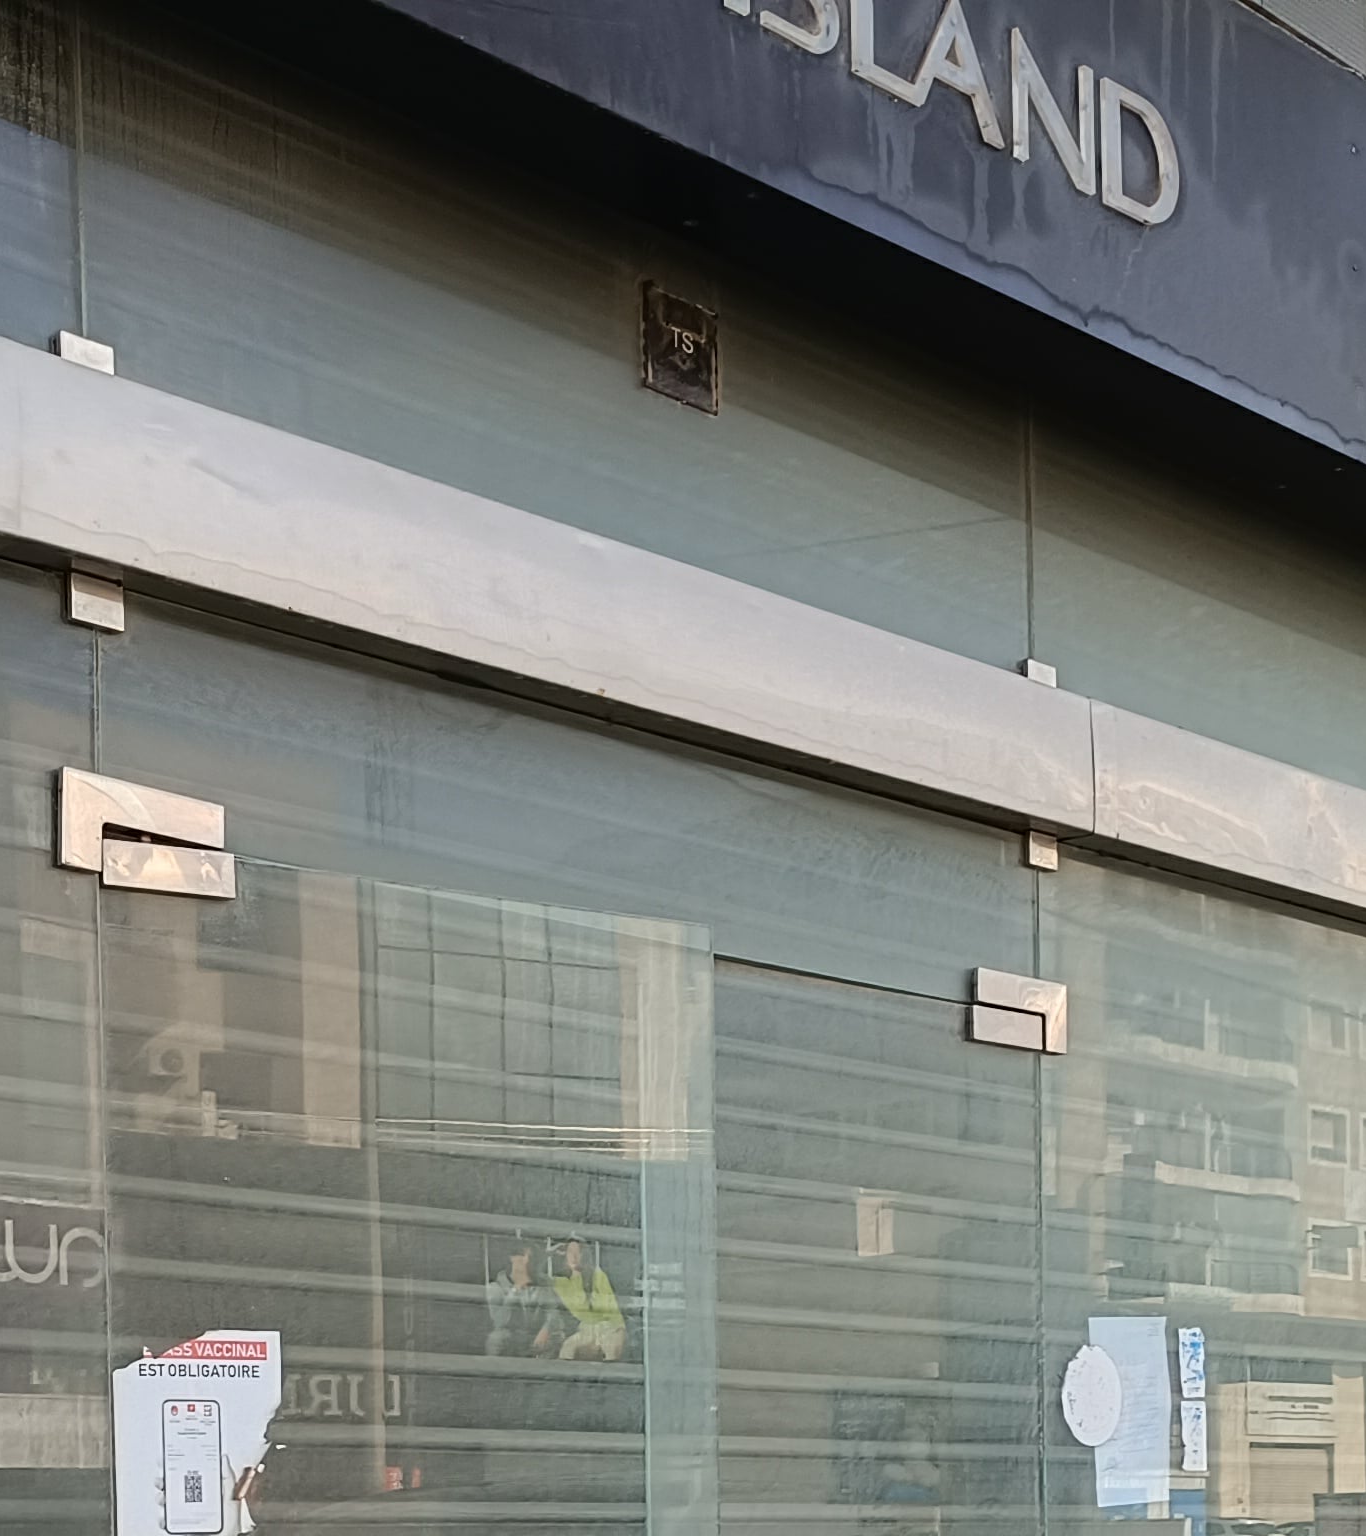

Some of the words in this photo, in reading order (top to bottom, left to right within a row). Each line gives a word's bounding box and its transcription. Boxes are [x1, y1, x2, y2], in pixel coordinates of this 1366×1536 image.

[724, 0, 1181, 226] LAND
[194, 1342, 266, 1358] VACCINAL
[138, 1364, 166, 1377] EST
[168, 1364, 261, 1378] OBLIGATOIRE
